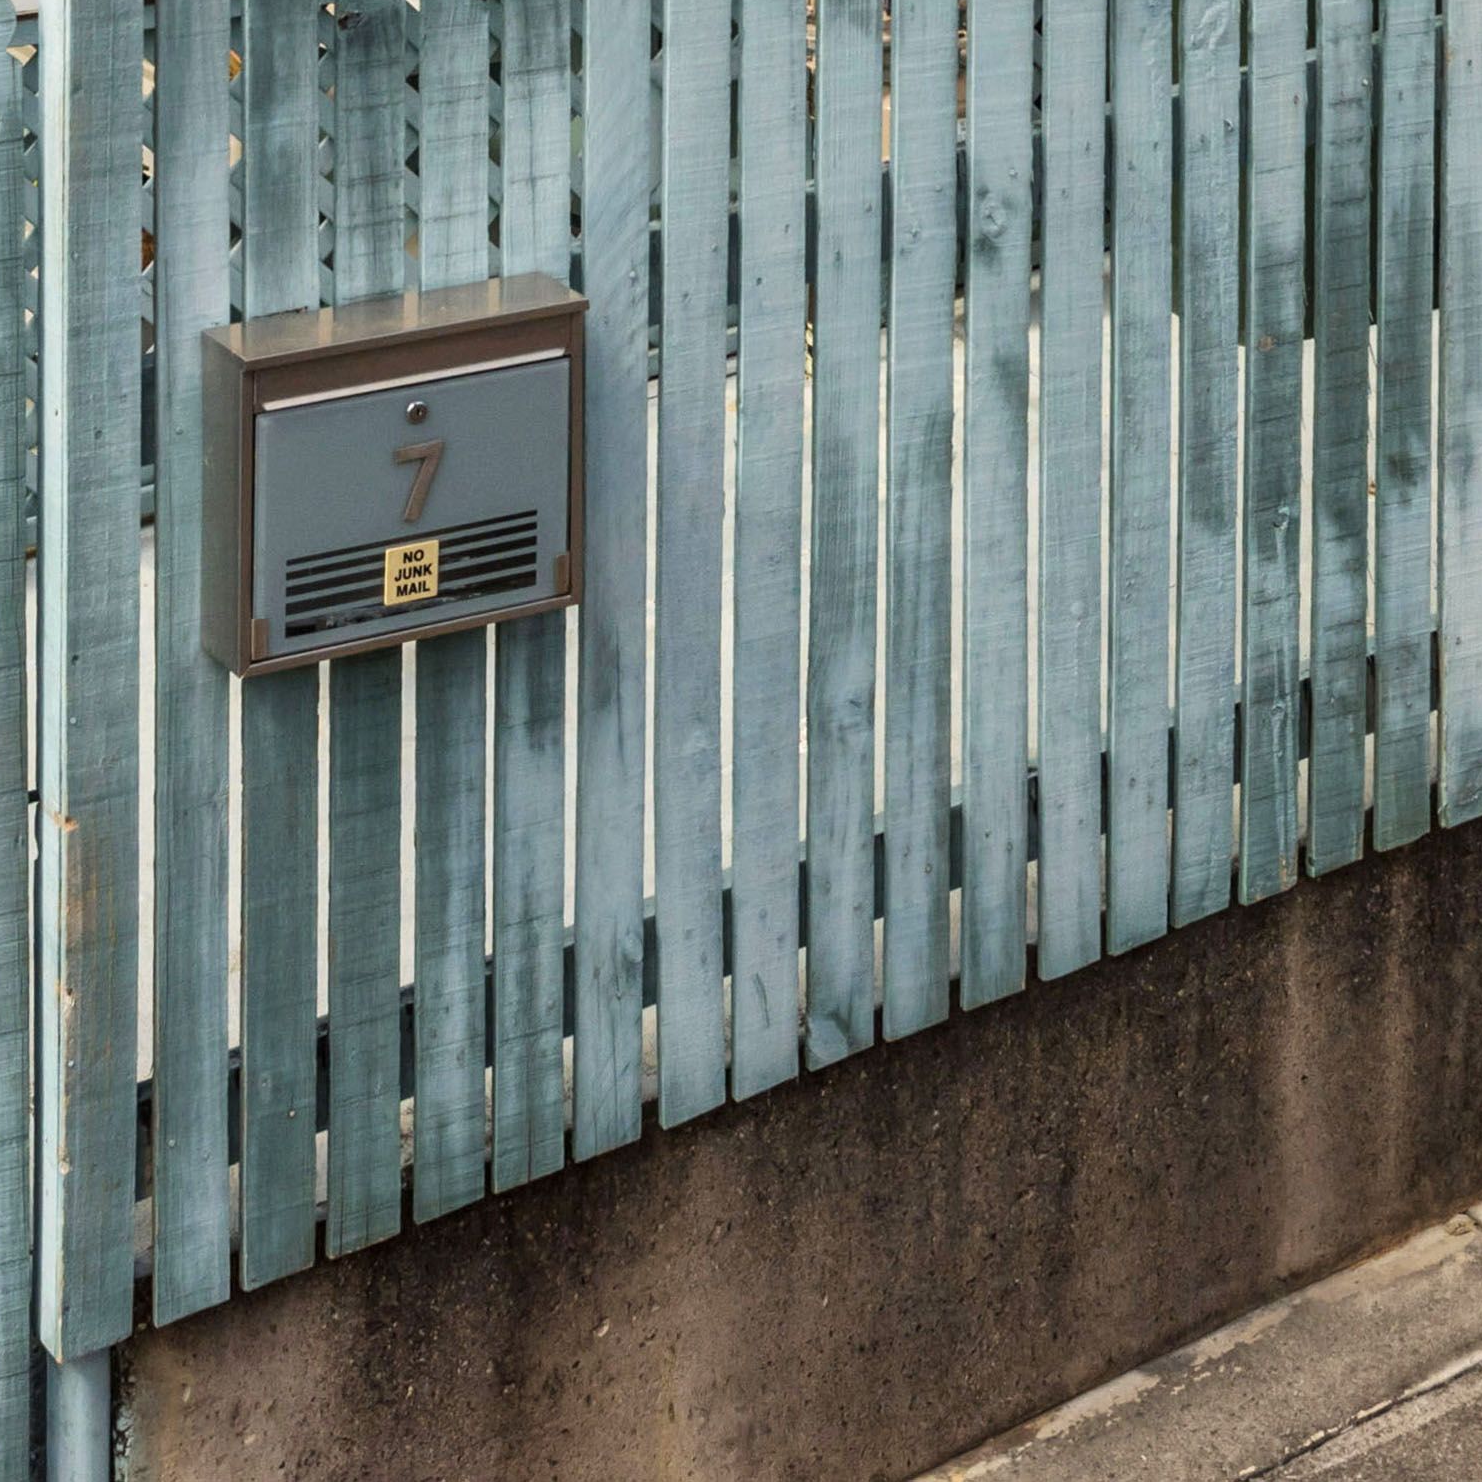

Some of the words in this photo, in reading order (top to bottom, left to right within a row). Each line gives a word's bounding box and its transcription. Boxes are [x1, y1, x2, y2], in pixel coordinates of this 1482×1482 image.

[392, 440, 446, 524] 7
[403, 549, 424, 564] NO
[394, 563, 433, 582] JUNK
[396, 581, 430, 597] MAIL
